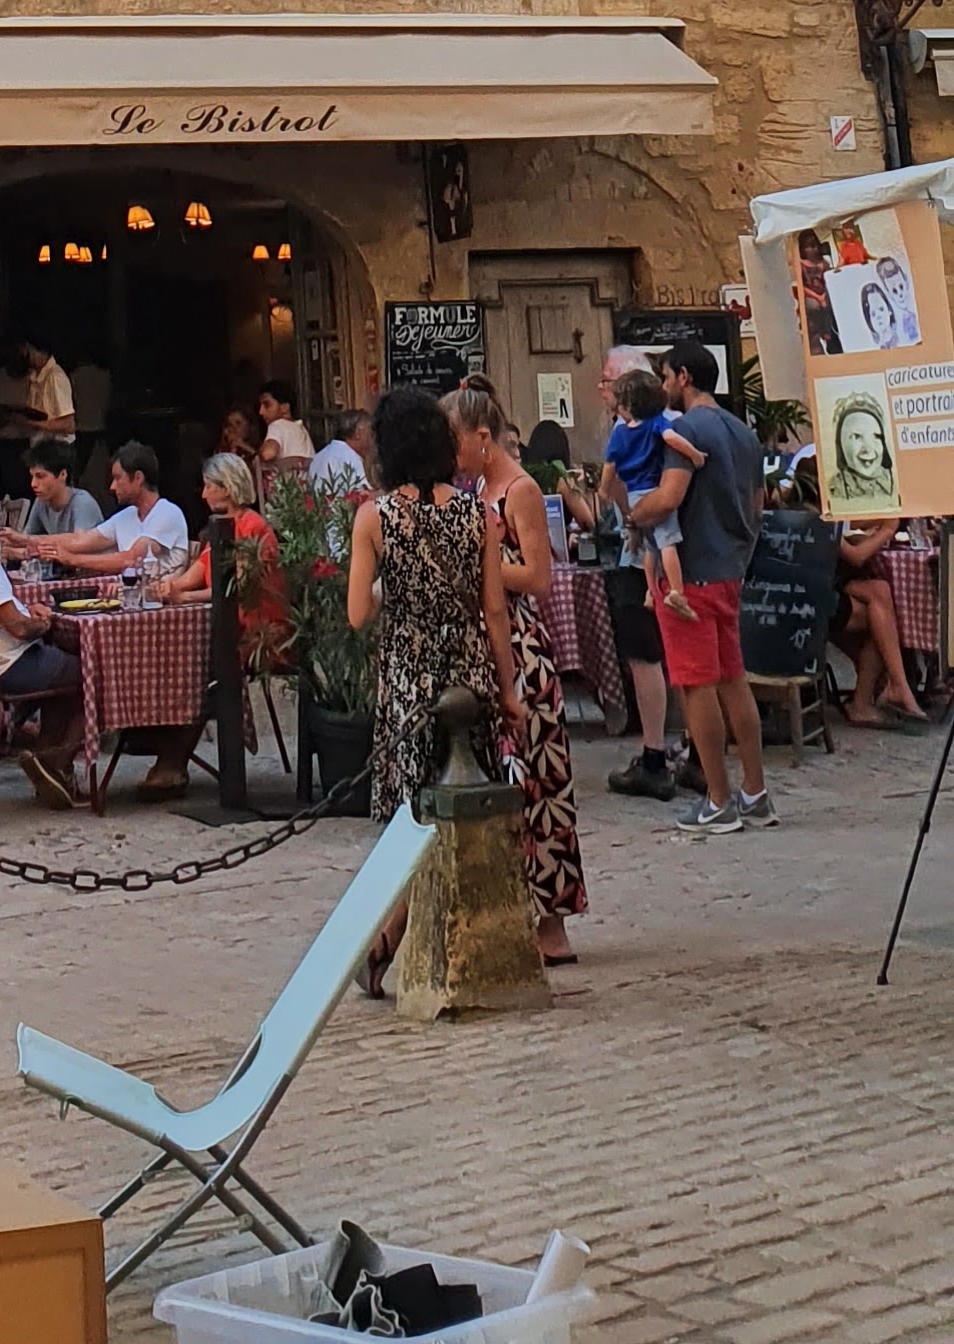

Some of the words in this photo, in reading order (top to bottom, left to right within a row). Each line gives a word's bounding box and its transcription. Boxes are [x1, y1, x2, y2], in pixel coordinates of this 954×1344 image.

[101, 104, 166, 136] Le
[180, 103, 339, 134] Bistrot
[394, 305, 476, 326] FORMULE
[894, 398, 905, 416] et
